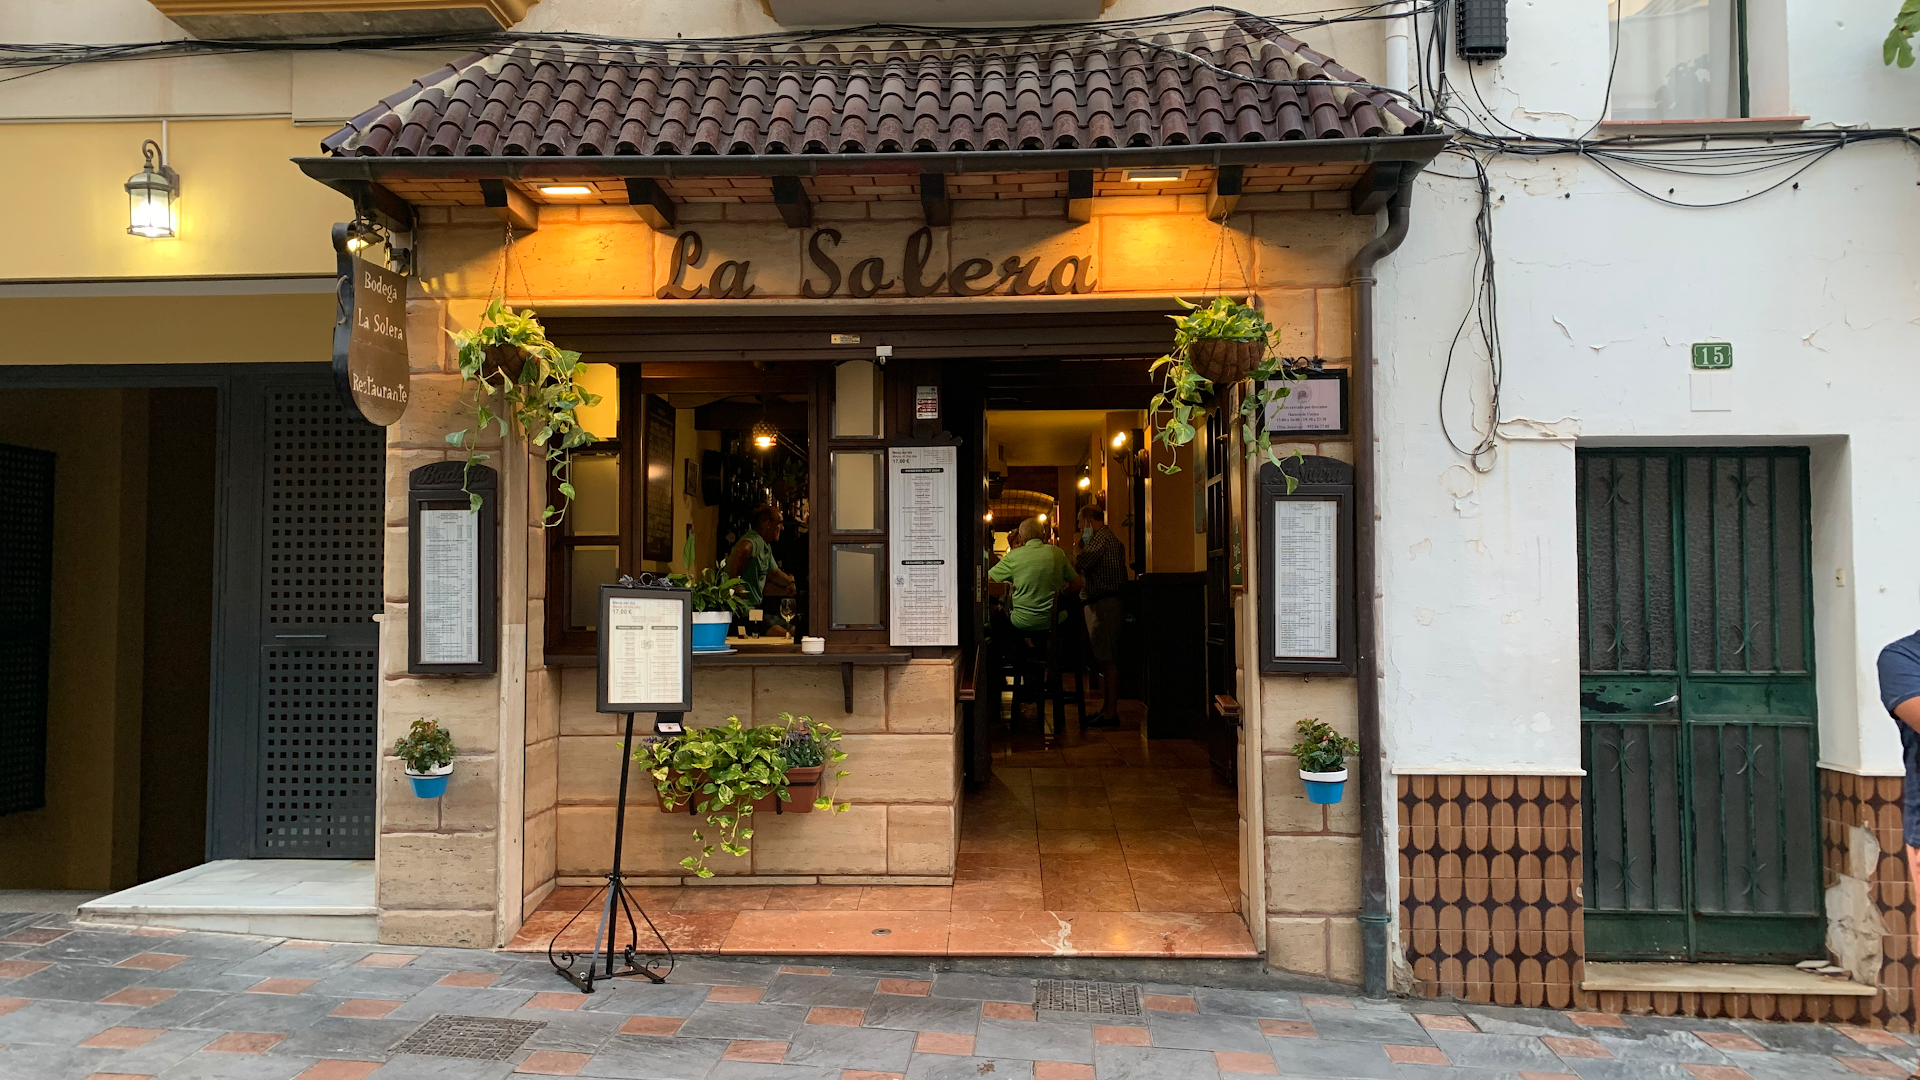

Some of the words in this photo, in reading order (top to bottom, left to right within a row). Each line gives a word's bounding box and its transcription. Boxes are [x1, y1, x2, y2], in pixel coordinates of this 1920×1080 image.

[655, 230, 755, 299] La
[802, 225, 1099, 299] Solera
[364, 271, 398, 303] Bodega
[357, 307, 370, 330] La
[373, 315, 404, 341] Solera
[1702, 346, 1724, 365] 15
[352, 372, 408, 403] Restaurante
[416, 463, 489, 485] Bodega
